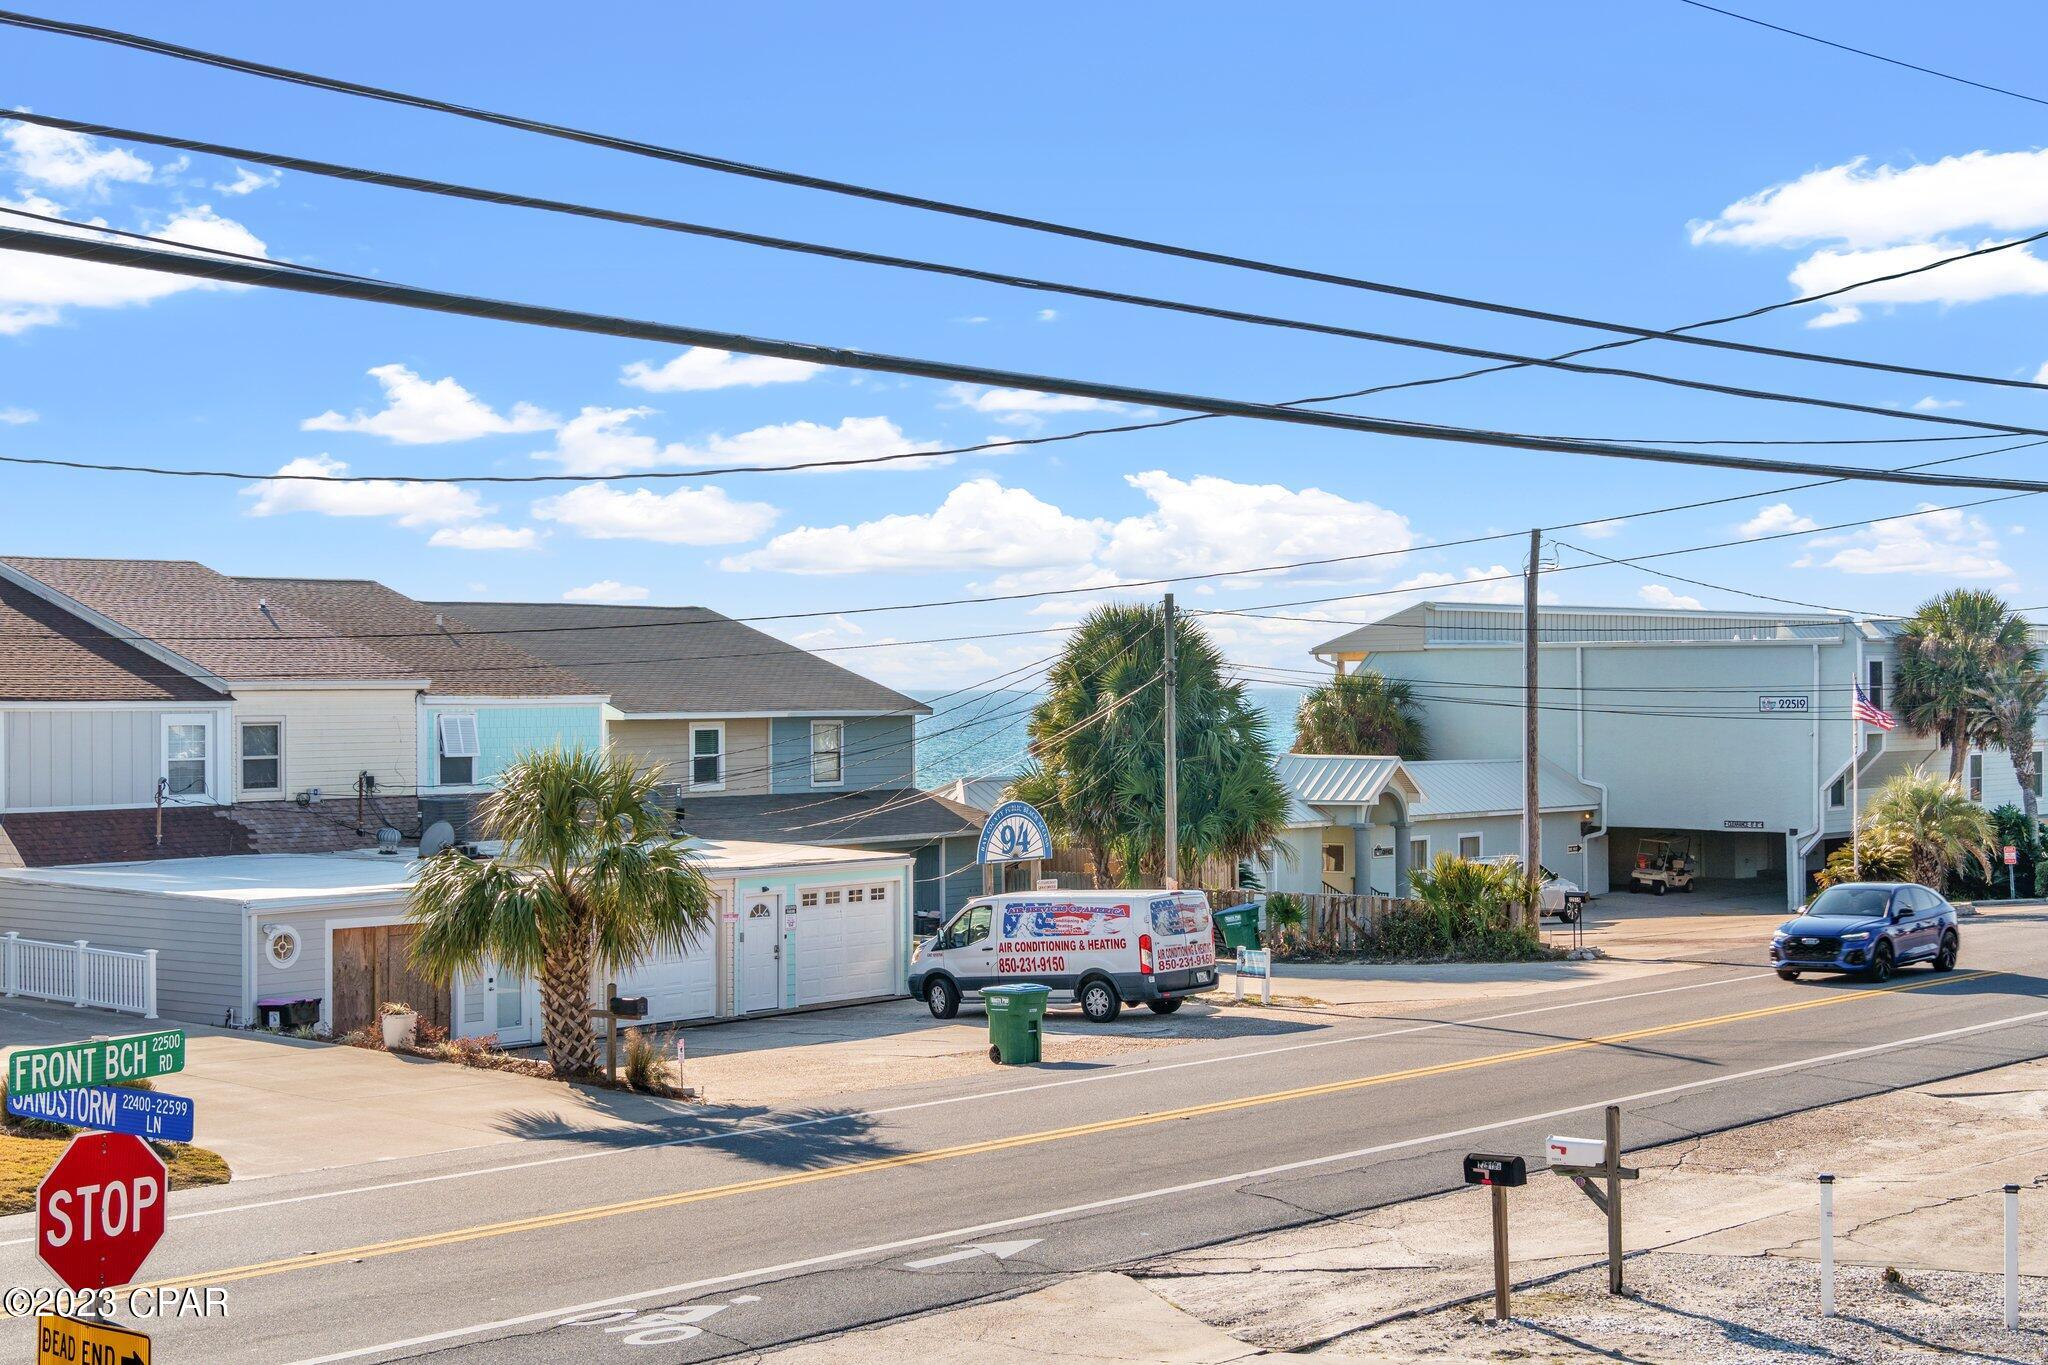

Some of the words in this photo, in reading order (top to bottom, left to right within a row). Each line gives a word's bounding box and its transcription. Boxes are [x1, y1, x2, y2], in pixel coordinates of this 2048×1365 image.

[1778, 698, 1806, 709] 22519
[1000, 821, 1031, 854] 94
[998, 942, 1013, 953] AIR
[1014, 940, 1076, 953] CONDITIONING
[1079, 939, 1086, 951] &
[1087, 938, 1127, 950] HEATING
[998, 955, 1065, 973] 850-231-9150
[1158, 954, 1213, 971] 850-231-9150
[15, 1047, 97, 1091] FRONT
[105, 1040, 147, 1080] BCH
[152, 1033, 181, 1052] 22500
[159, 1054, 173, 1072] RD
[122, 1094, 188, 1117] 22400-22599
[146, 1114, 162, 1134] LN
[46, 1175, 159, 1247] STOP
[42, 1327, 76, 1361] DEAD
[81, 1340, 116, 1365] END
